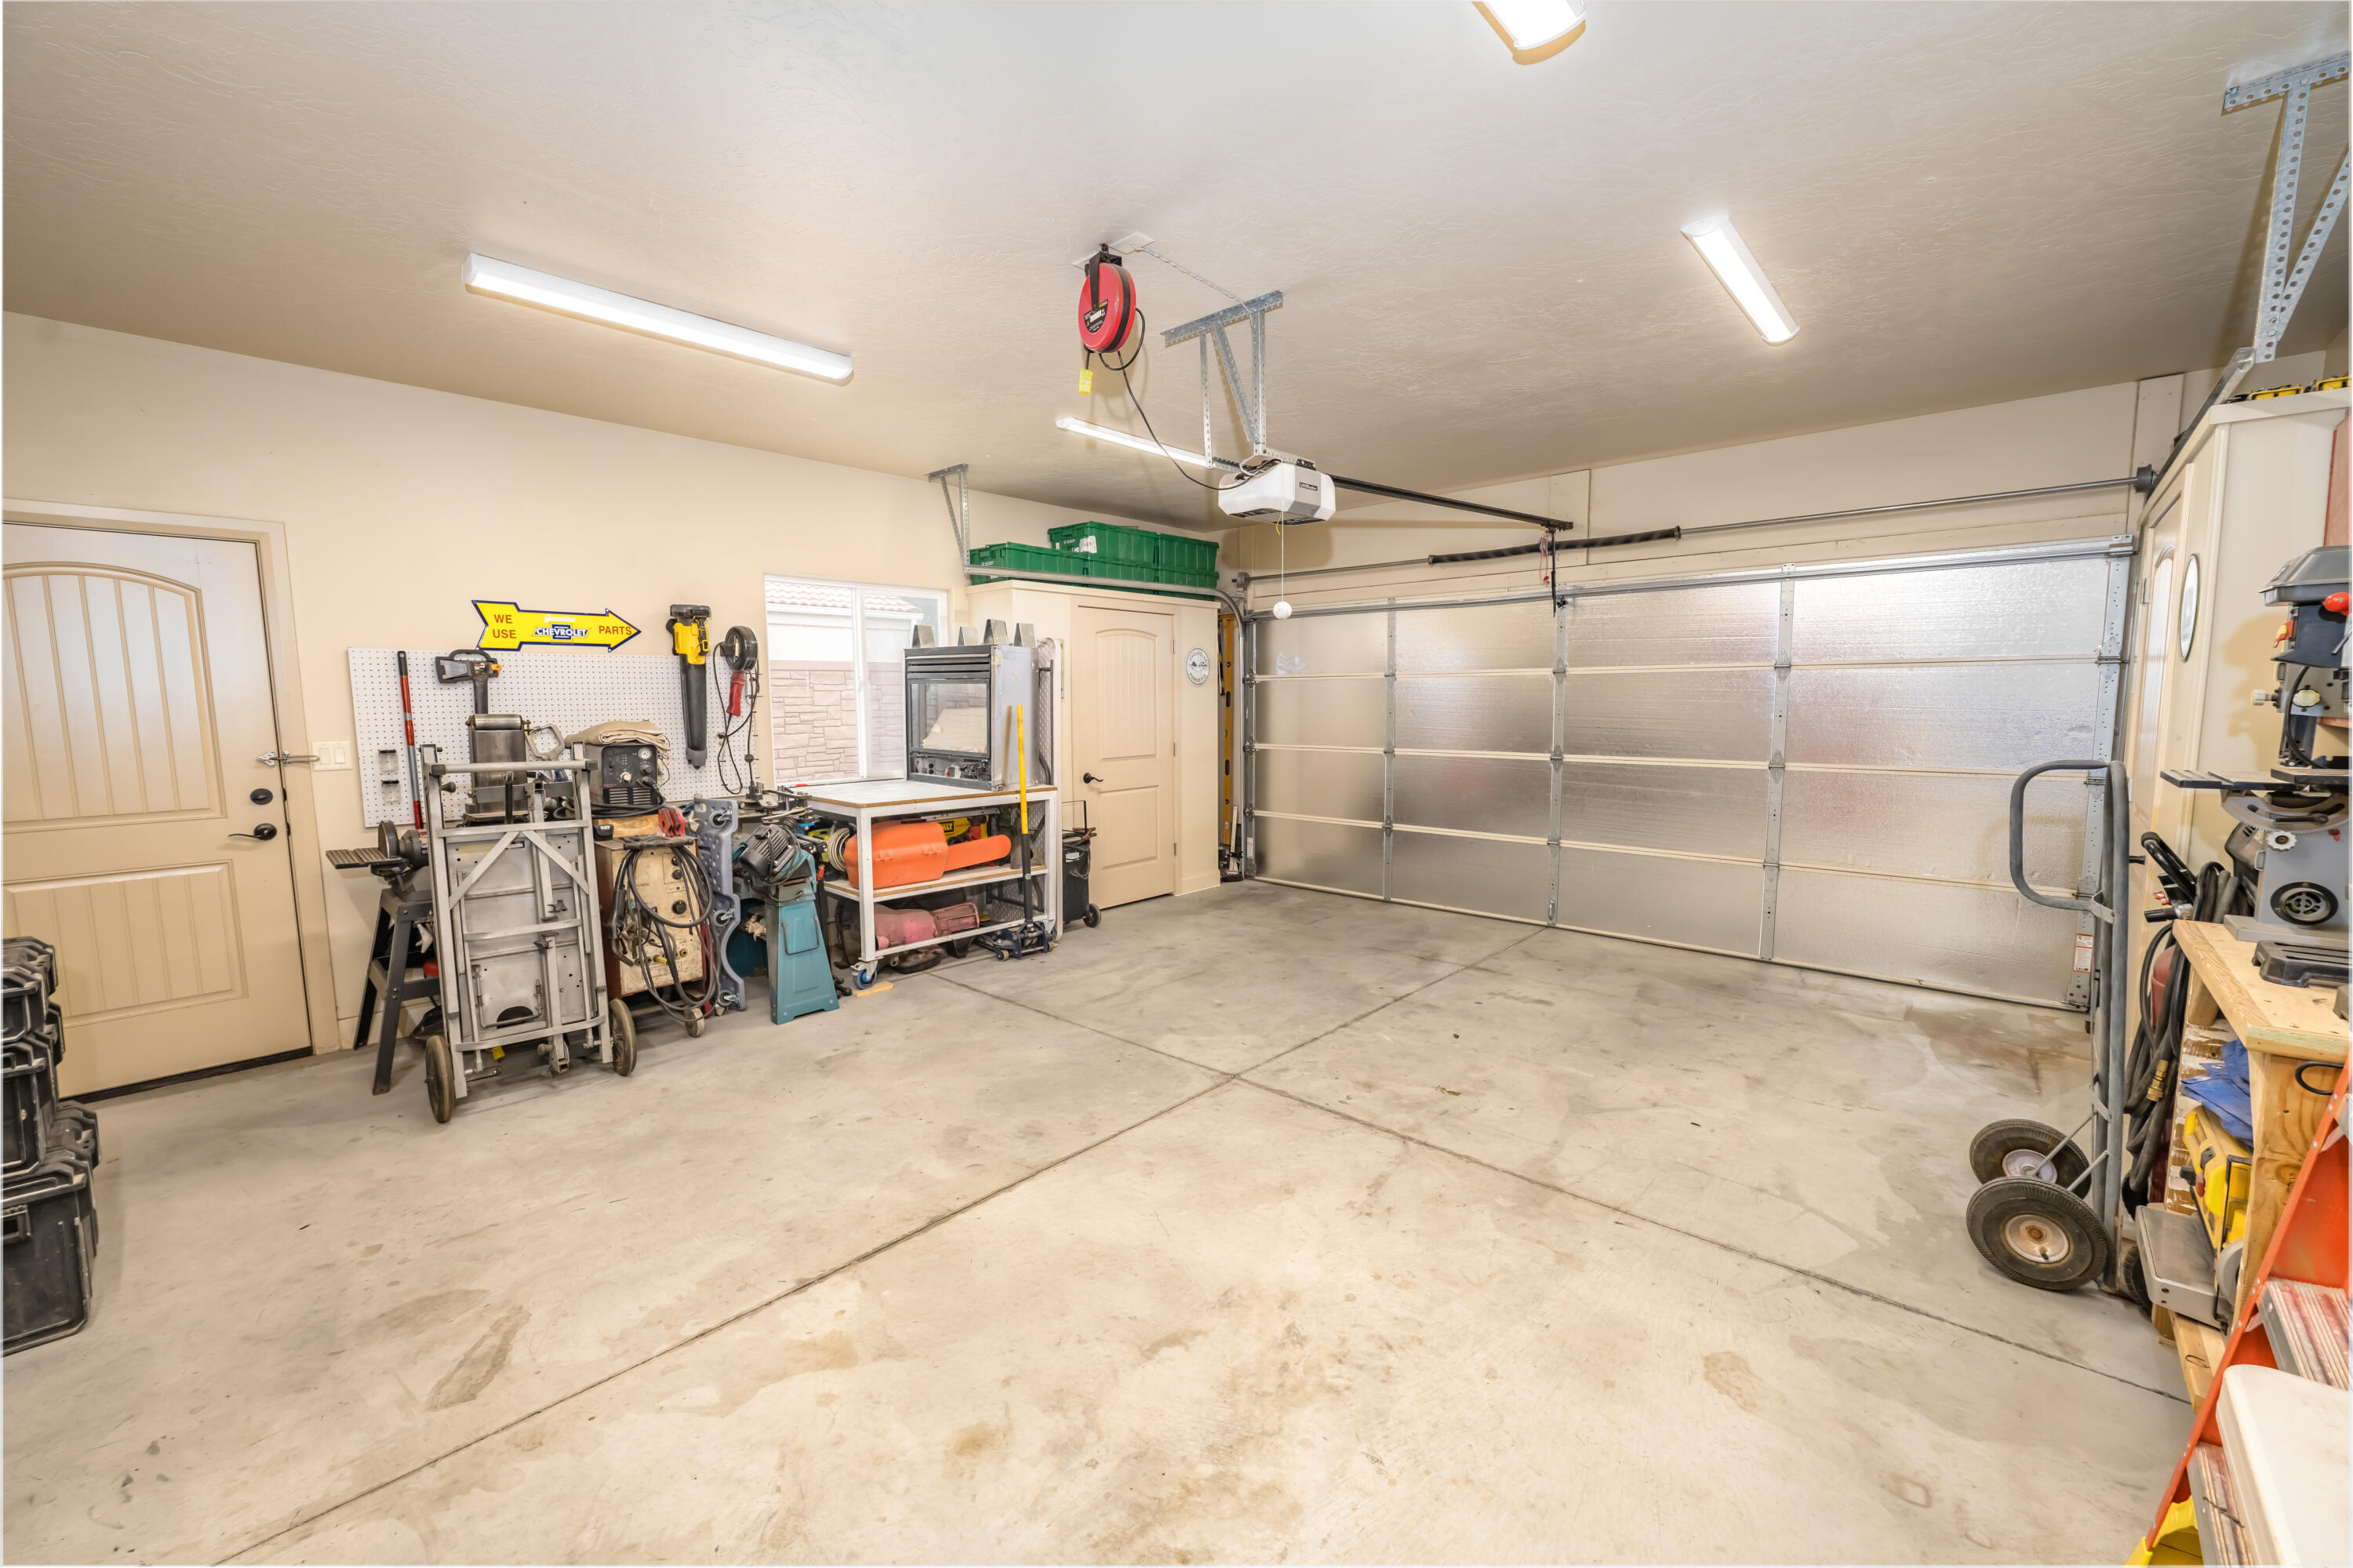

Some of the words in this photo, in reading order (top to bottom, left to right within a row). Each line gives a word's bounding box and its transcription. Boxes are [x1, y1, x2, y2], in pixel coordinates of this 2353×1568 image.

[493, 614, 513, 624] WE
[493, 629, 516, 638] USE
[536, 628, 587, 636] CHEVROLET
[598, 625, 632, 635] PARTS
